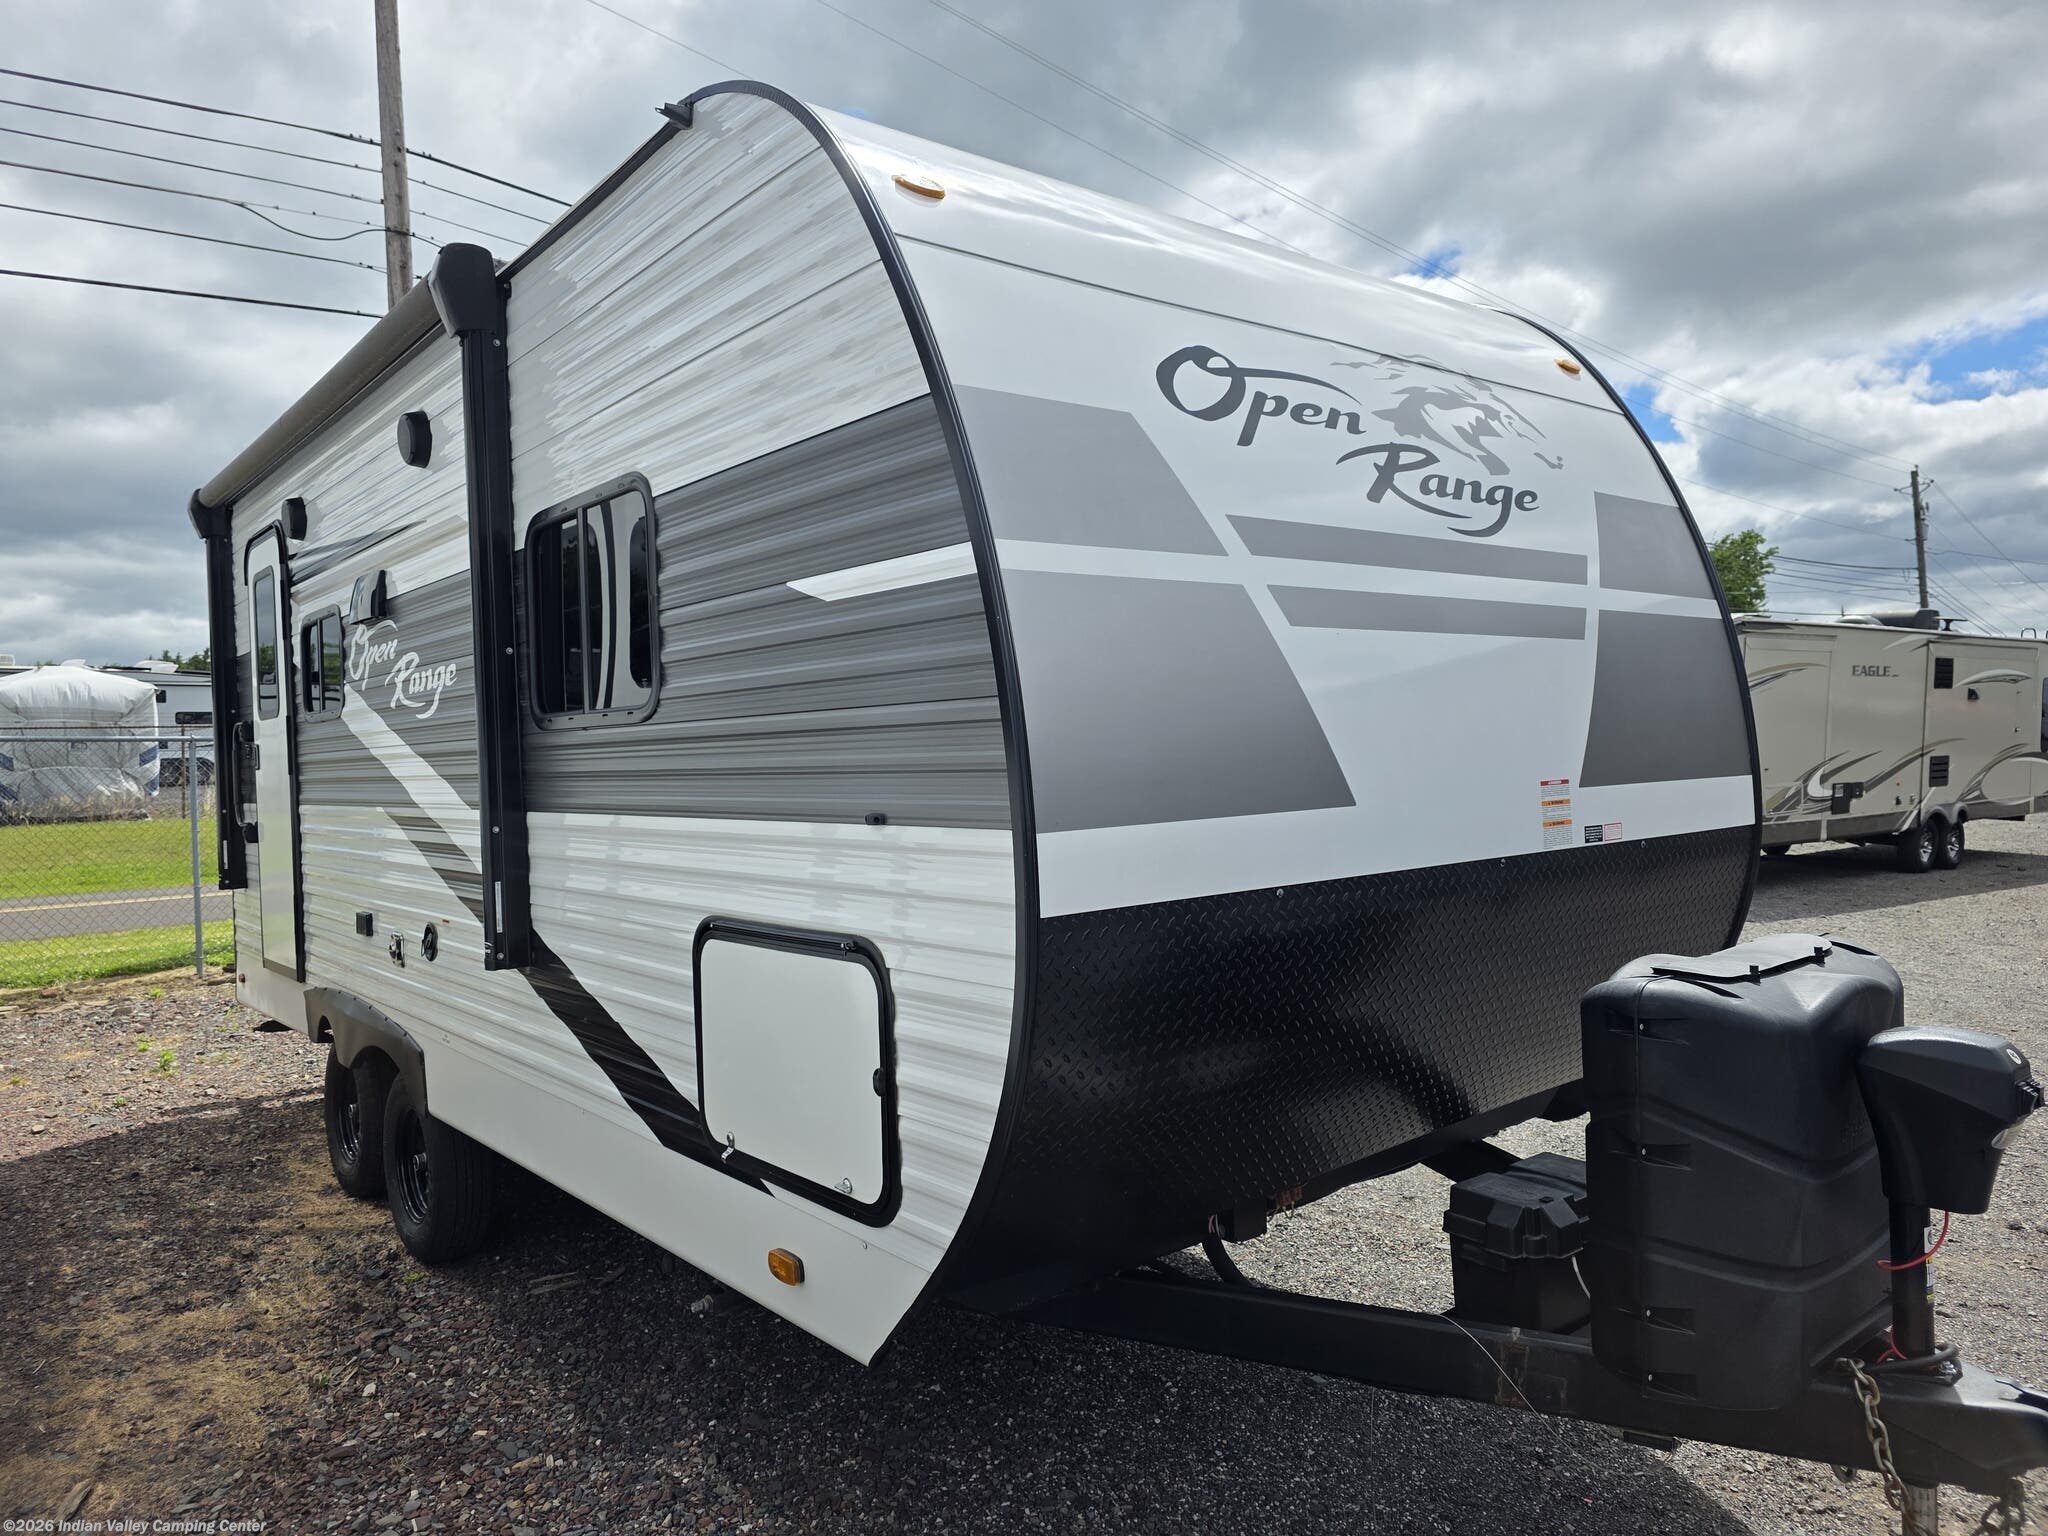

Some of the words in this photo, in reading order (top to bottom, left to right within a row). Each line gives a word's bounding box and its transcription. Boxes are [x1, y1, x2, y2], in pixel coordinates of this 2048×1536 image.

[1155, 345, 1366, 447] Open
[1336, 441, 1540, 538] Range
[348, 619, 399, 692] Open
[384, 651, 457, 719] Range
[1851, 664, 1891, 677] EAGLE
